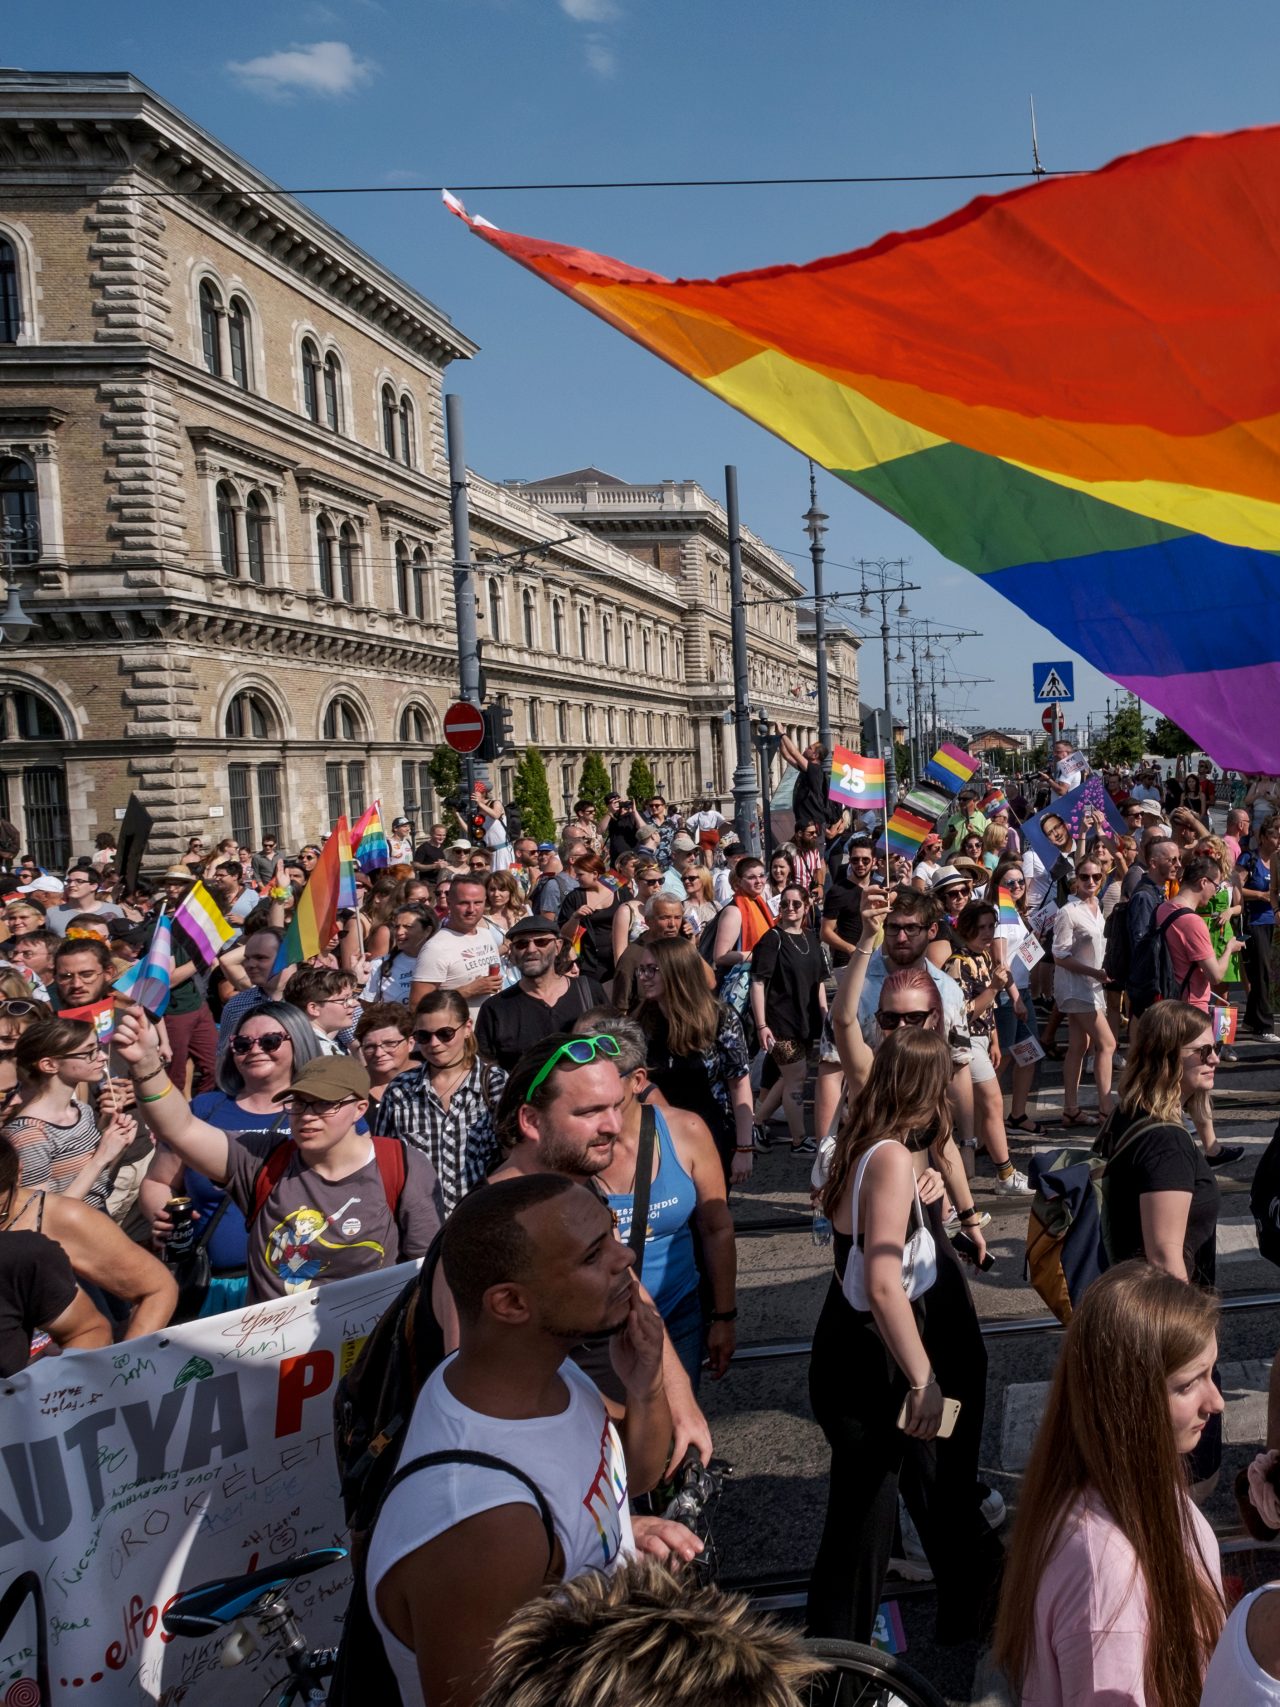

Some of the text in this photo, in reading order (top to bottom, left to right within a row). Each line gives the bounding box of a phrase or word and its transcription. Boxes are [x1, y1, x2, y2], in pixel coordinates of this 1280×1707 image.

[840, 763, 866, 794] 25
[465, 959, 478, 972] LEE
[649, 1197, 679, 1211] INDIG
[184, 1466, 224, 1488] LOVE
